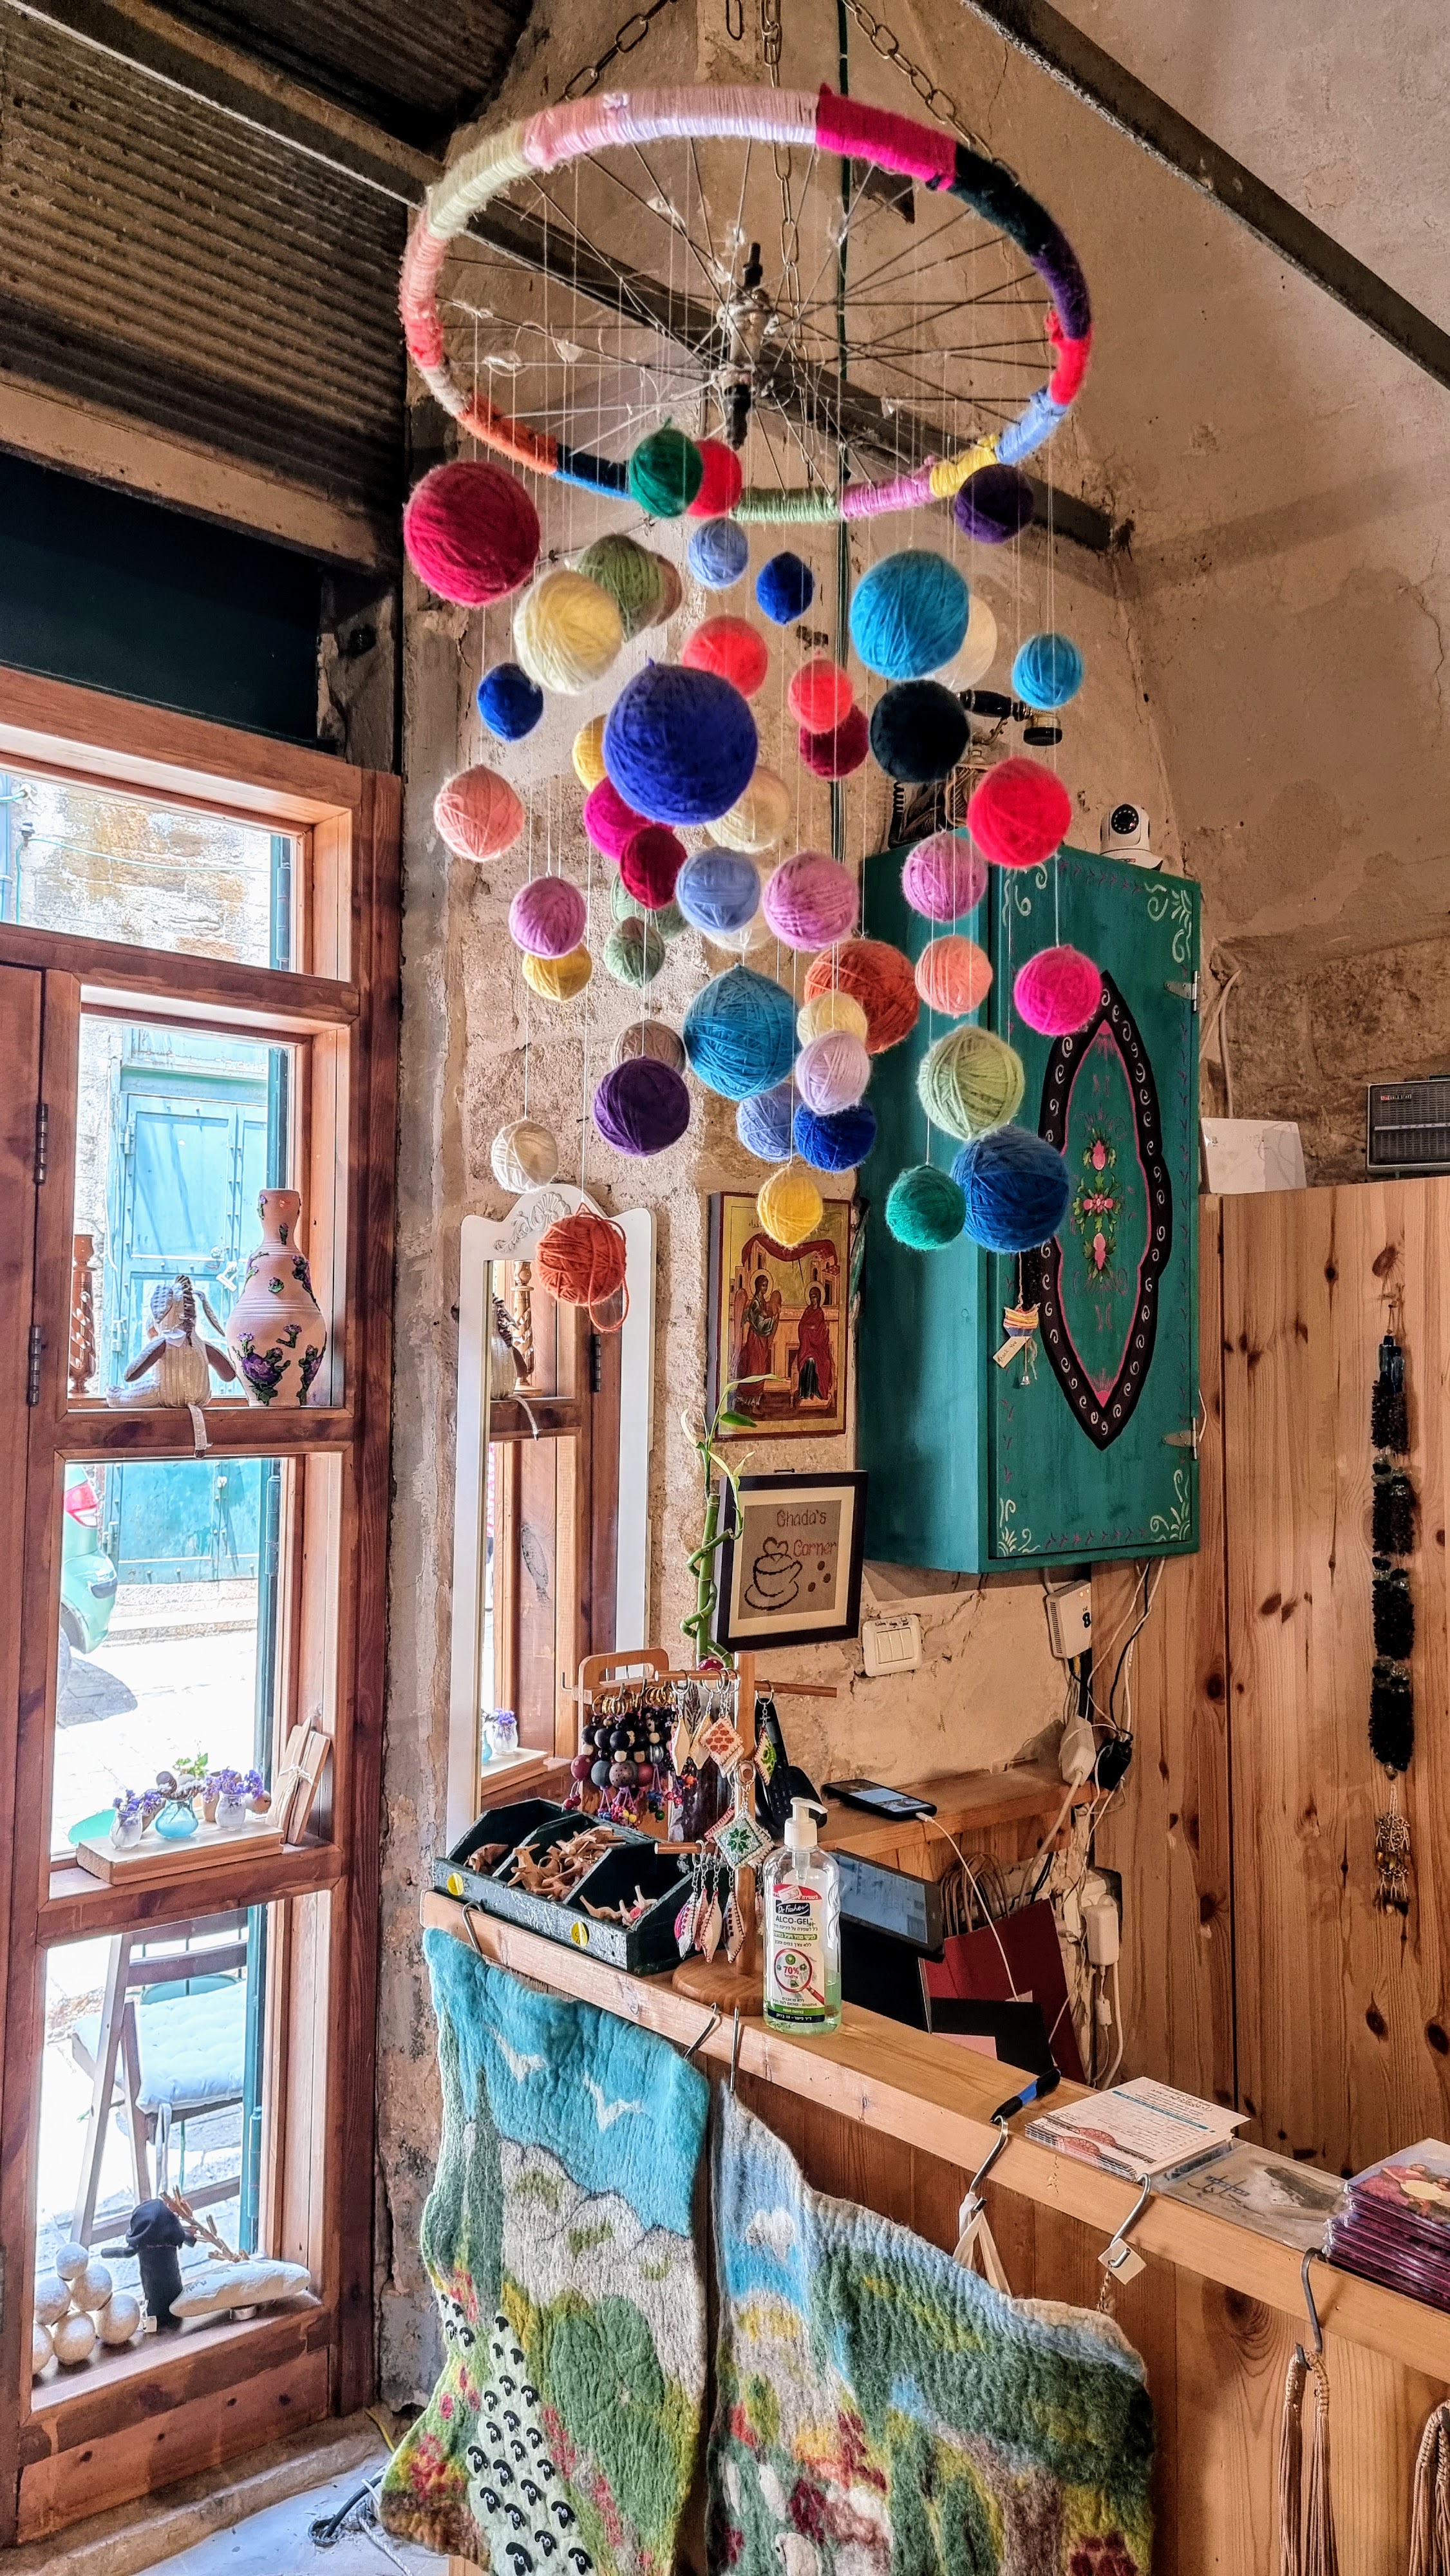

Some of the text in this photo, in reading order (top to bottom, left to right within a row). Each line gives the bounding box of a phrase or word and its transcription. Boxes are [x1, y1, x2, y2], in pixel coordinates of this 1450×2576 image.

[777, 1510, 827, 1527] Ghada's
[793, 1539, 837, 1557] Corner
[776, 1915, 811, 1924] ALCO-GEL
[783, 1966, 800, 1975] 70%
